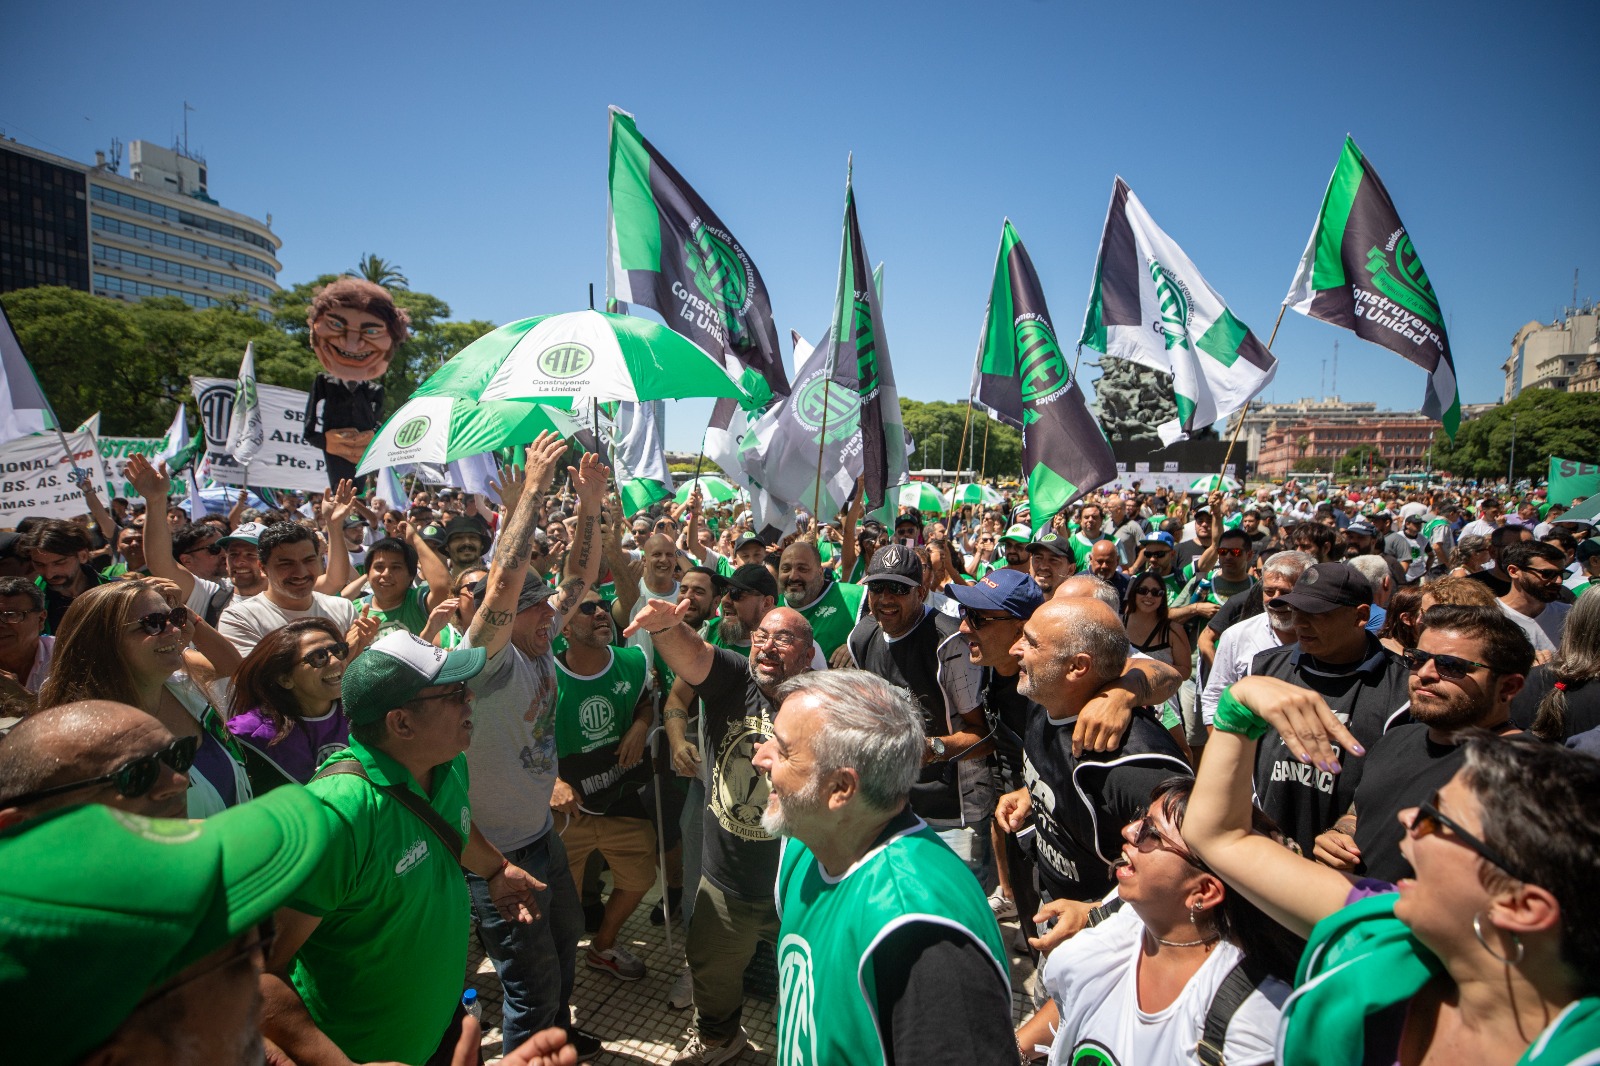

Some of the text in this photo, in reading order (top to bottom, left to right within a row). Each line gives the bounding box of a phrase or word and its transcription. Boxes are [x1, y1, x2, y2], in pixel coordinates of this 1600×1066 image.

[1385, 230, 1402, 252] Unidos
[733, 244, 756, 298] organizados
[680, 303, 695, 322] la
[1177, 279, 1196, 327] organizados
[1352, 284, 1444, 352] onstruyendo
[1365, 306, 1428, 346] Unidad
[545, 347, 586, 373] ATE
[399, 419, 426, 443] ATE
[275, 453, 311, 470] Pte.
[2, 480, 30, 493] BS.
[36, 475, 61, 489] AS.
[67, 467, 94, 483] SR
[0, 498, 36, 510] MAS
[54, 484, 103, 504] ZAMA
[582, 701, 609, 730] ATE
